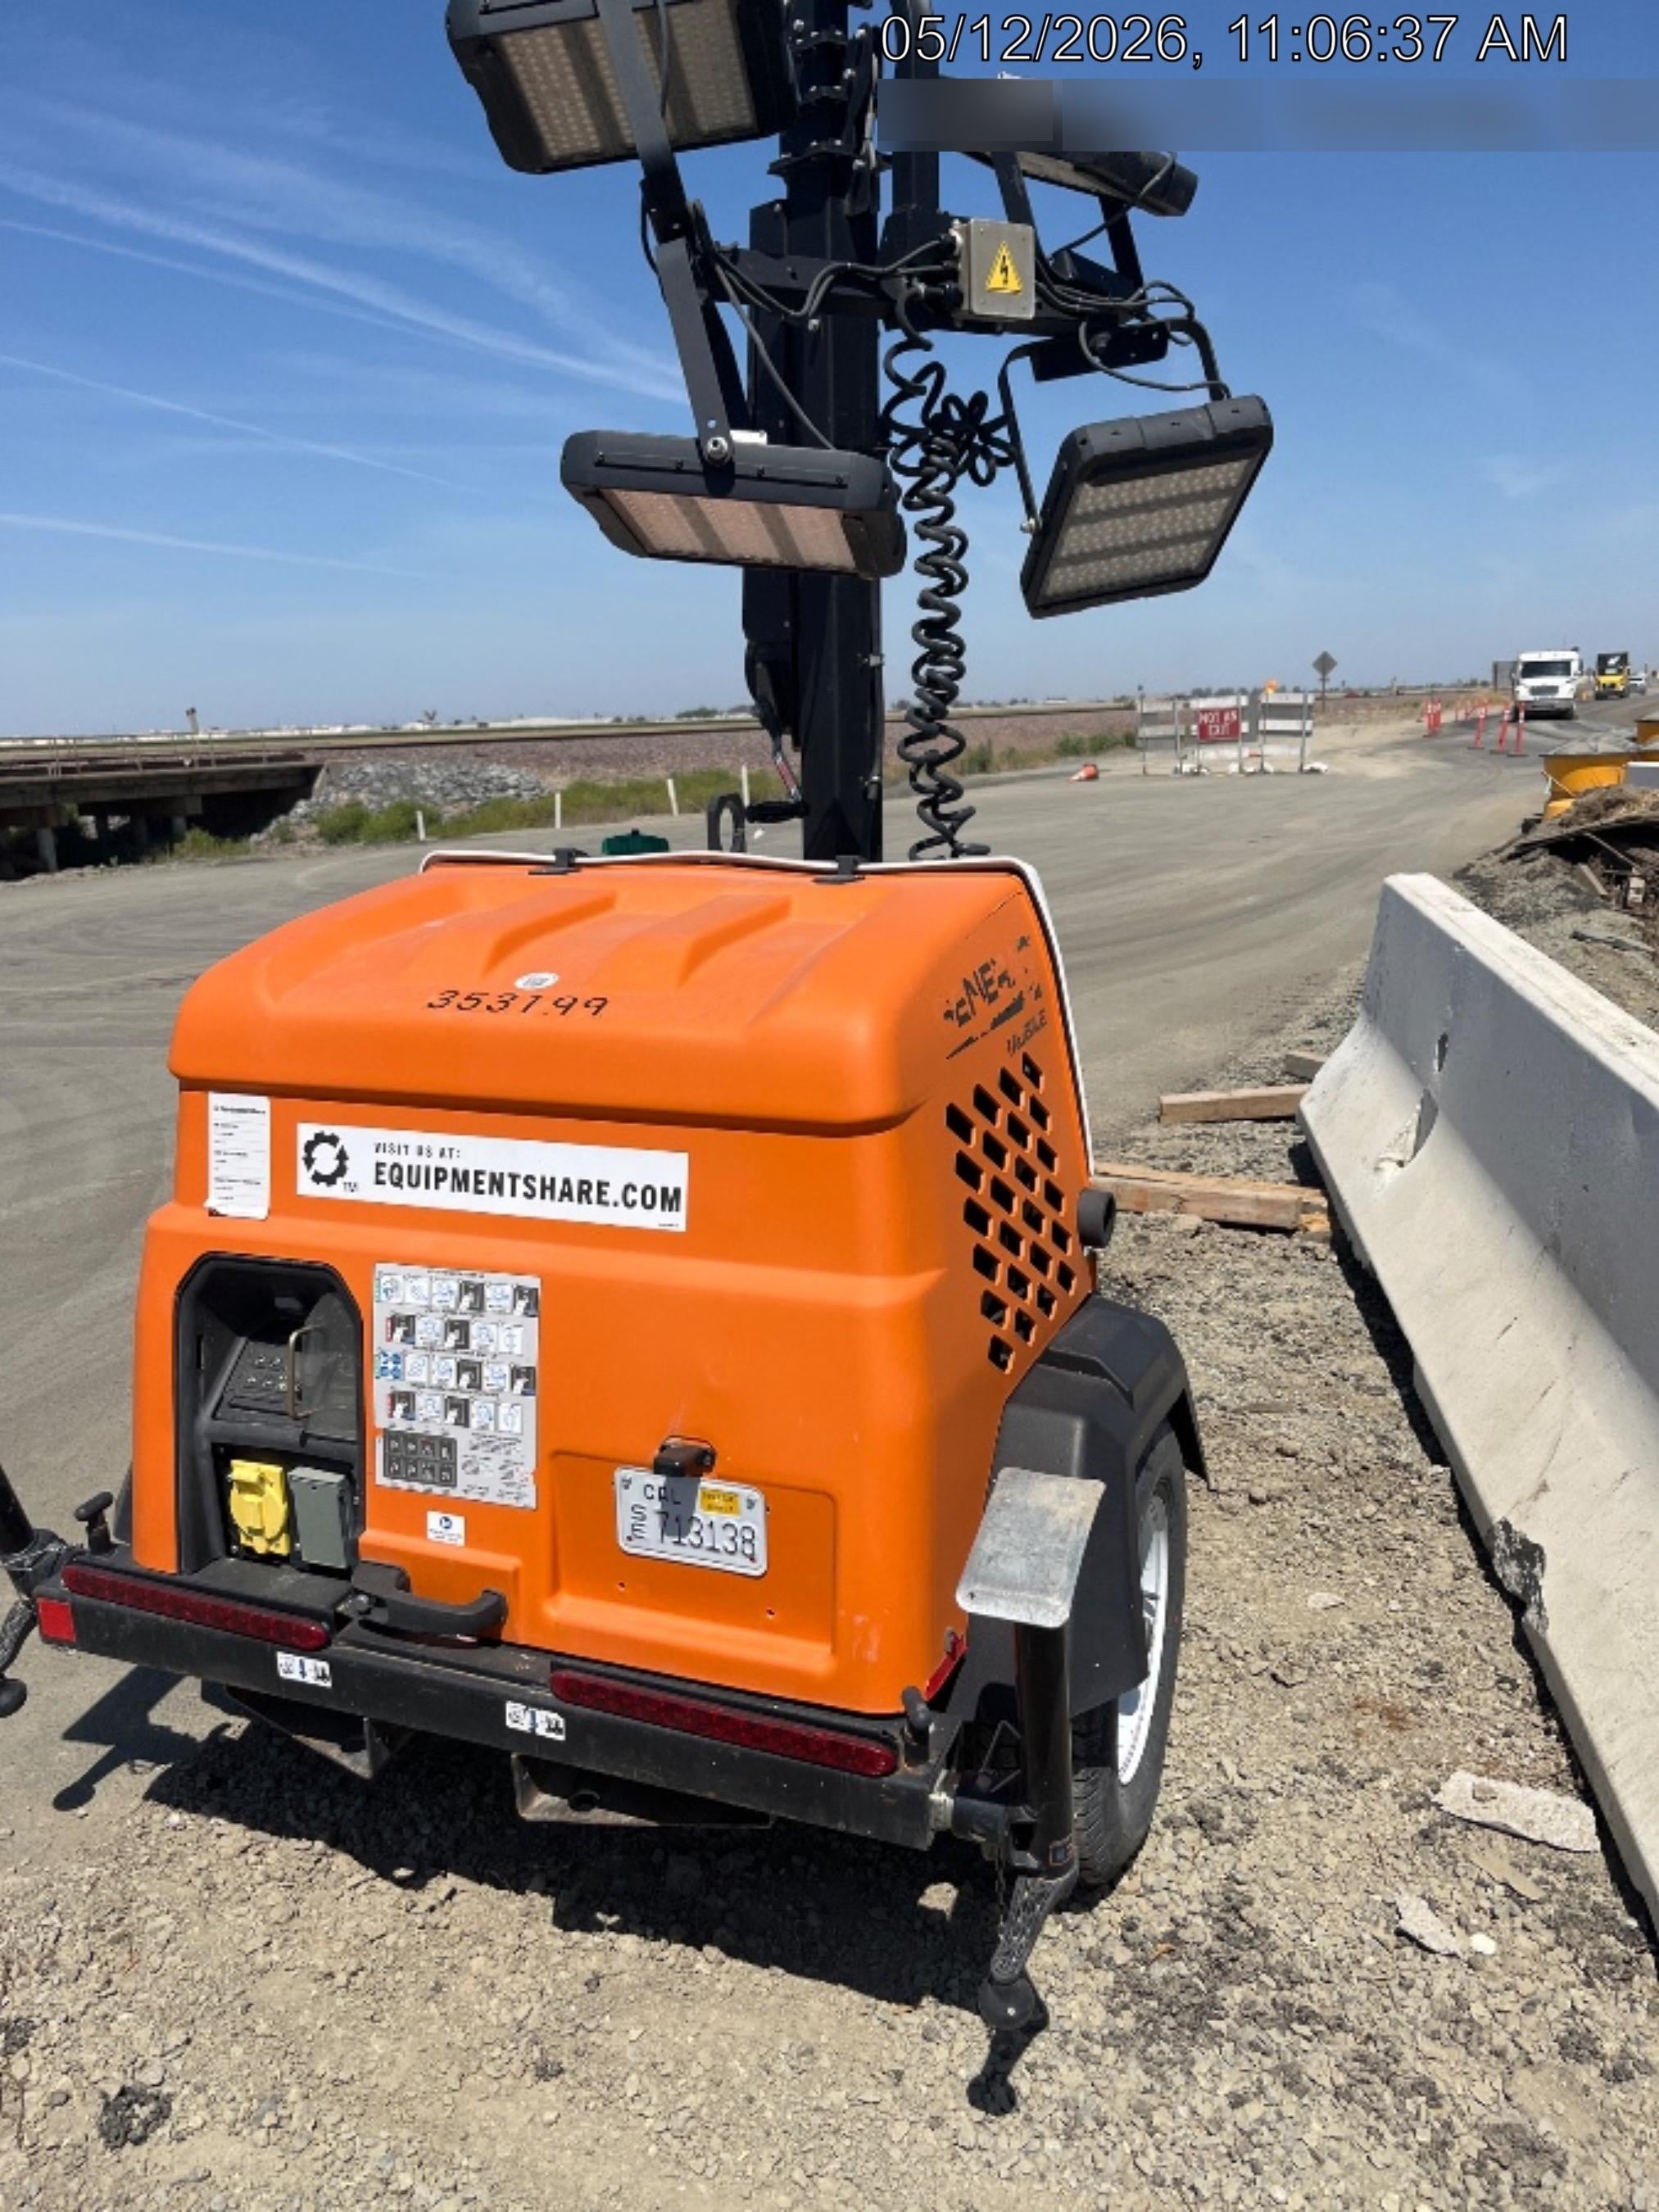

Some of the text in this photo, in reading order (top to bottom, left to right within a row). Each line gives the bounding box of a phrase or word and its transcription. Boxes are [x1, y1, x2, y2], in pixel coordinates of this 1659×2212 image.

[374, 1142, 460, 1159] VISIT US AT:
[374, 1161, 682, 1213] EQUIPMENTSHARE.COM
[655, 1510, 756, 1558] 713138
